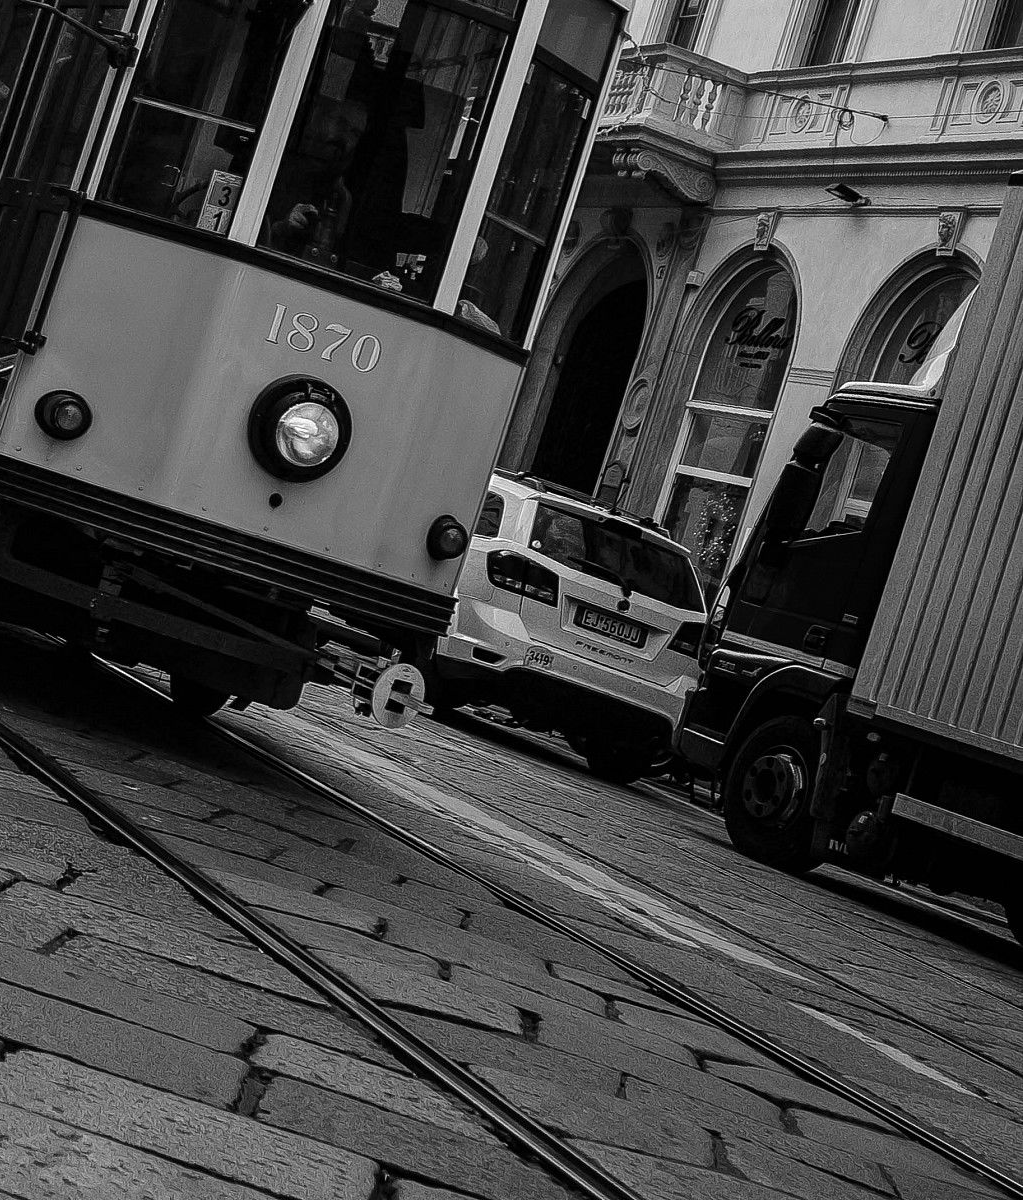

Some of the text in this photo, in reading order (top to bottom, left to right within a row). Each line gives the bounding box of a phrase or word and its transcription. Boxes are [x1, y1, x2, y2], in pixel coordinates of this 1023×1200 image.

[218, 186, 231, 206] 3
[213, 210, 224, 231] 1
[265, 303, 382, 373] 1870
